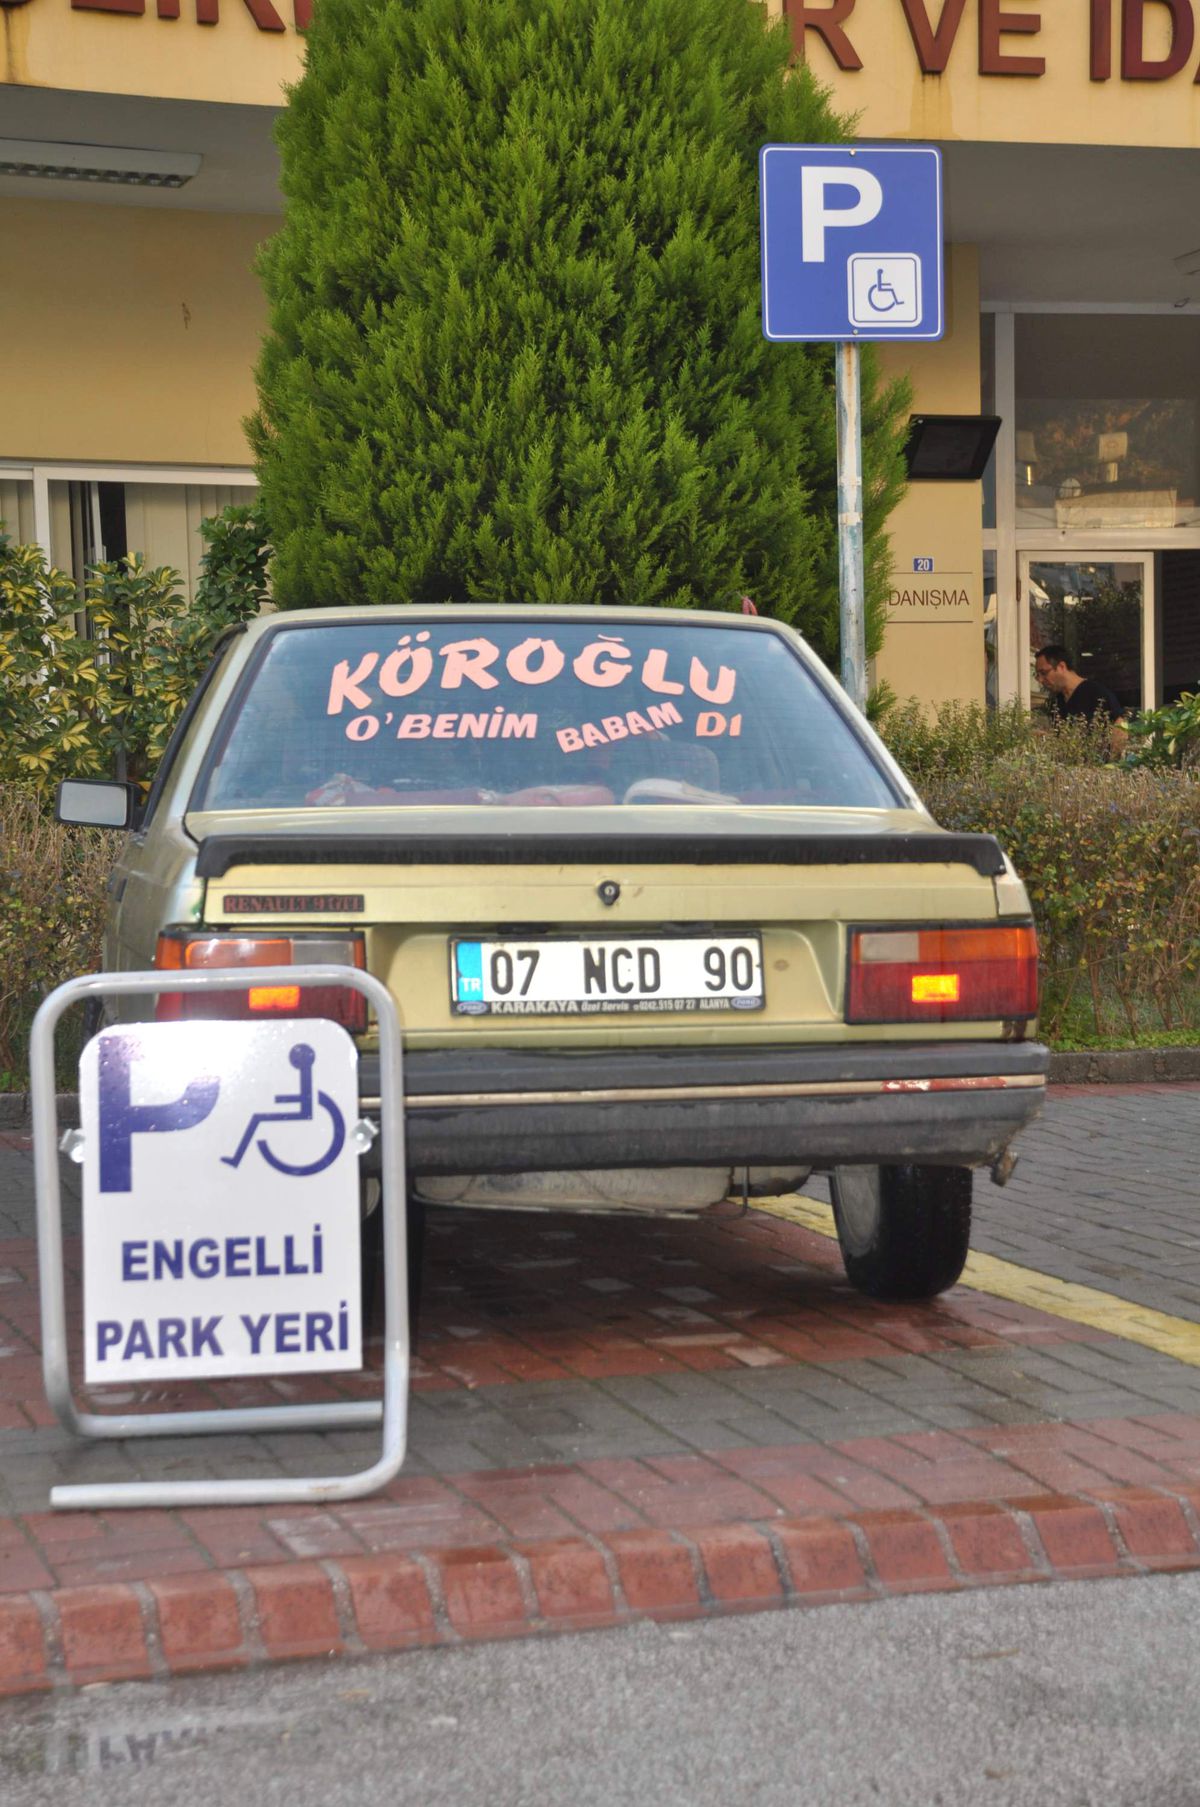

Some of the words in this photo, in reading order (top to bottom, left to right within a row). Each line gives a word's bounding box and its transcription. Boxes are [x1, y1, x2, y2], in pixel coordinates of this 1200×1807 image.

[903, 0, 1045, 76] VE
[801, 166, 883, 262] P
[917, 558, 930, 571] 20
[888, 589, 970, 610] DANIŞMA
[327, 630, 737, 715] KÖROĞLU
[556, 701, 683, 753] BABAM
[224, 895, 307, 912] RENAULT
[462, 977, 481, 992] TR
[490, 949, 541, 996] 07
[583, 946, 661, 995] NCD
[703, 946, 753, 992] 90
[491, 1001, 579, 1014] KARAKAYA
[700, 998, 730, 1011] ALANYA
[121, 1223, 324, 1282] ENGELLİ
[96, 1315, 225, 1362] PARK
[240, 1300, 350, 1355] YERİ
